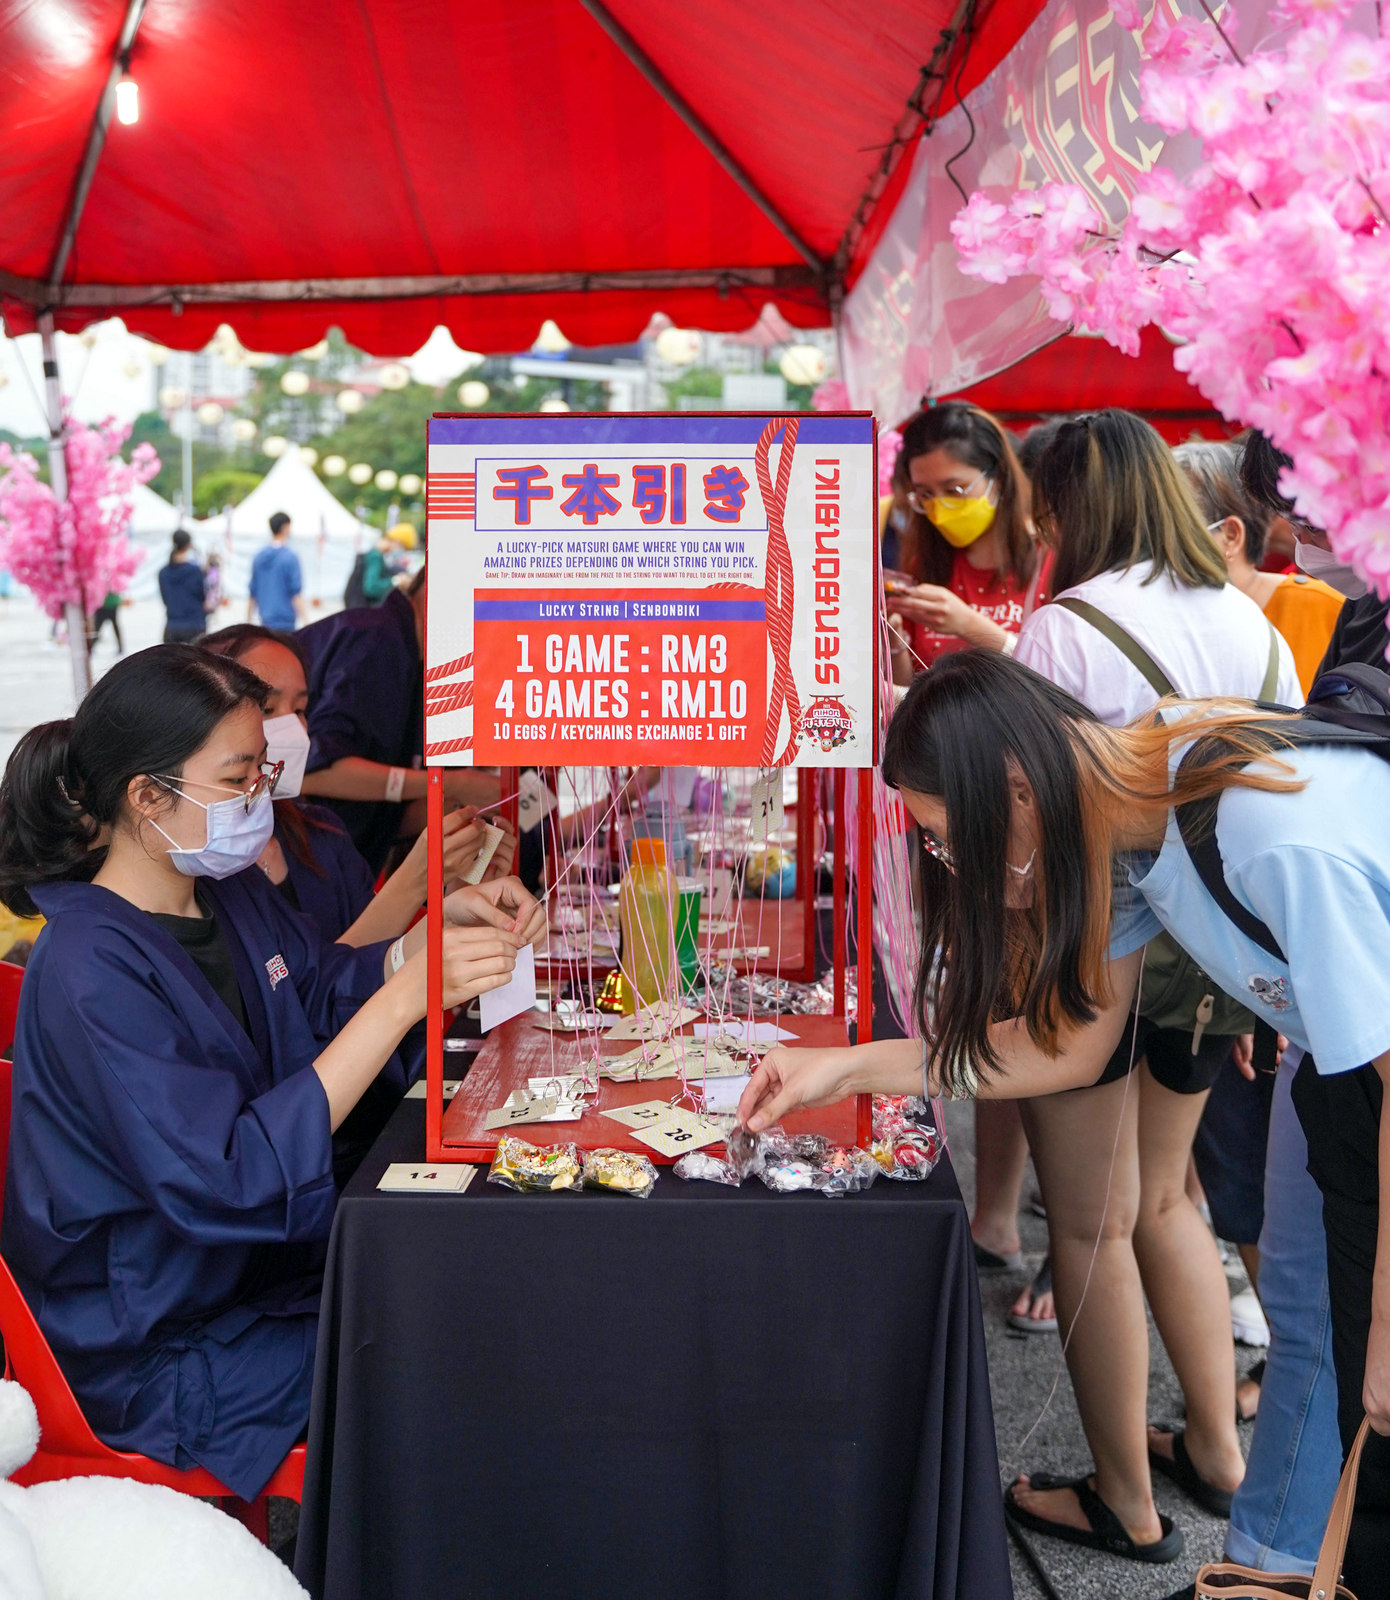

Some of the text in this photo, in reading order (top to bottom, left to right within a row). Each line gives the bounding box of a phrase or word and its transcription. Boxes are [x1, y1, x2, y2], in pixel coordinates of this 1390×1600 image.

[492, 463, 750, 526] 千本引き
[497, 541, 745, 553] A LUCKY-PICK MATSURI GAME WHERE YOU CAN WIN
[484, 556, 758, 568] AMAZING PRIZES DEPENDING ON WHICH STRING YOU PICK.
[539, 603, 574, 617] LUCKY
[579, 603, 620, 617] STRING
[633, 603, 700, 617] SENBONBIKI
[516, 634, 534, 673] 1
[545, 634, 630, 674] GAME
[661, 634, 727, 674] RM3
[495, 680, 515, 718] 4
[525, 679, 629, 719] GAMES
[661, 680, 747, 719] RM10
[801, 718, 852, 729] MATSURI
[493, 723, 510, 740] 10
[514, 724, 547, 740] EGGS
[561, 724, 633, 741] KEYCHAINS
[636, 724, 703, 741] EXCHANGE
[706, 723, 715, 740] 1
[718, 724, 748, 741] GIFT
[761, 796, 774, 818] 21
[664, 1128, 692, 1142] 28
[410, 1172, 438, 1180] 14
